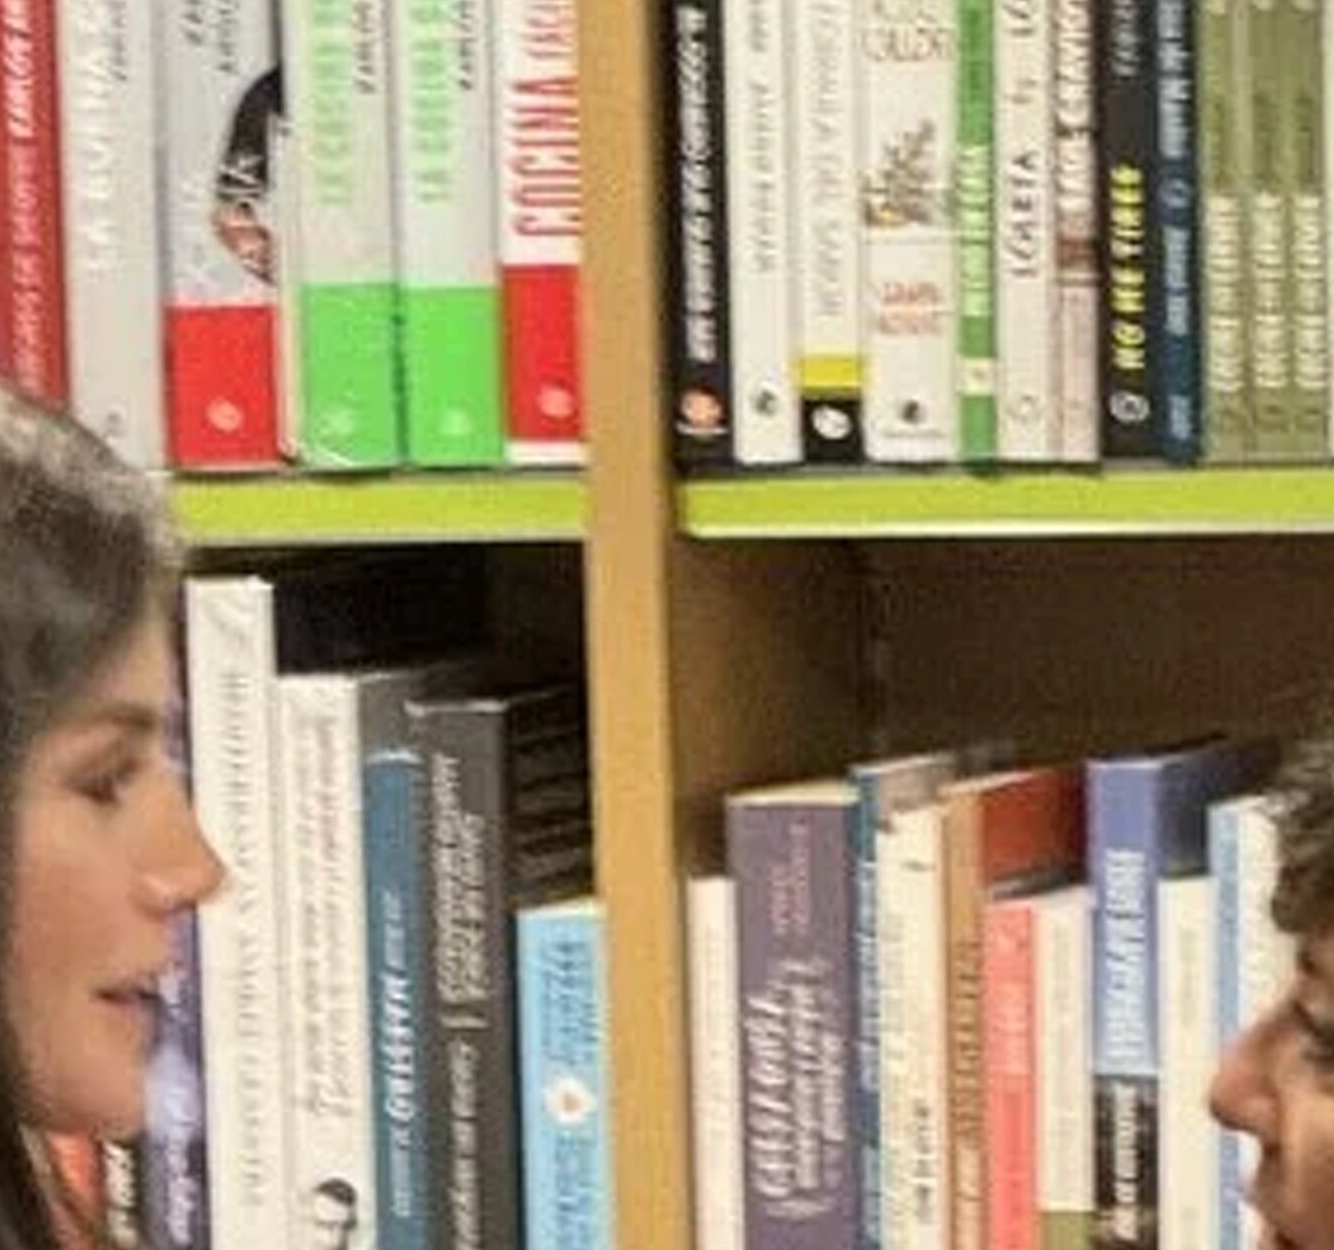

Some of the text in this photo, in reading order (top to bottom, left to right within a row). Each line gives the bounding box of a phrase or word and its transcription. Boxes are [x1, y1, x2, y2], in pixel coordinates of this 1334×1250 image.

[509, 76, 581, 237] COCINA
[1107, 163, 1141, 370] NO ME TIRES
